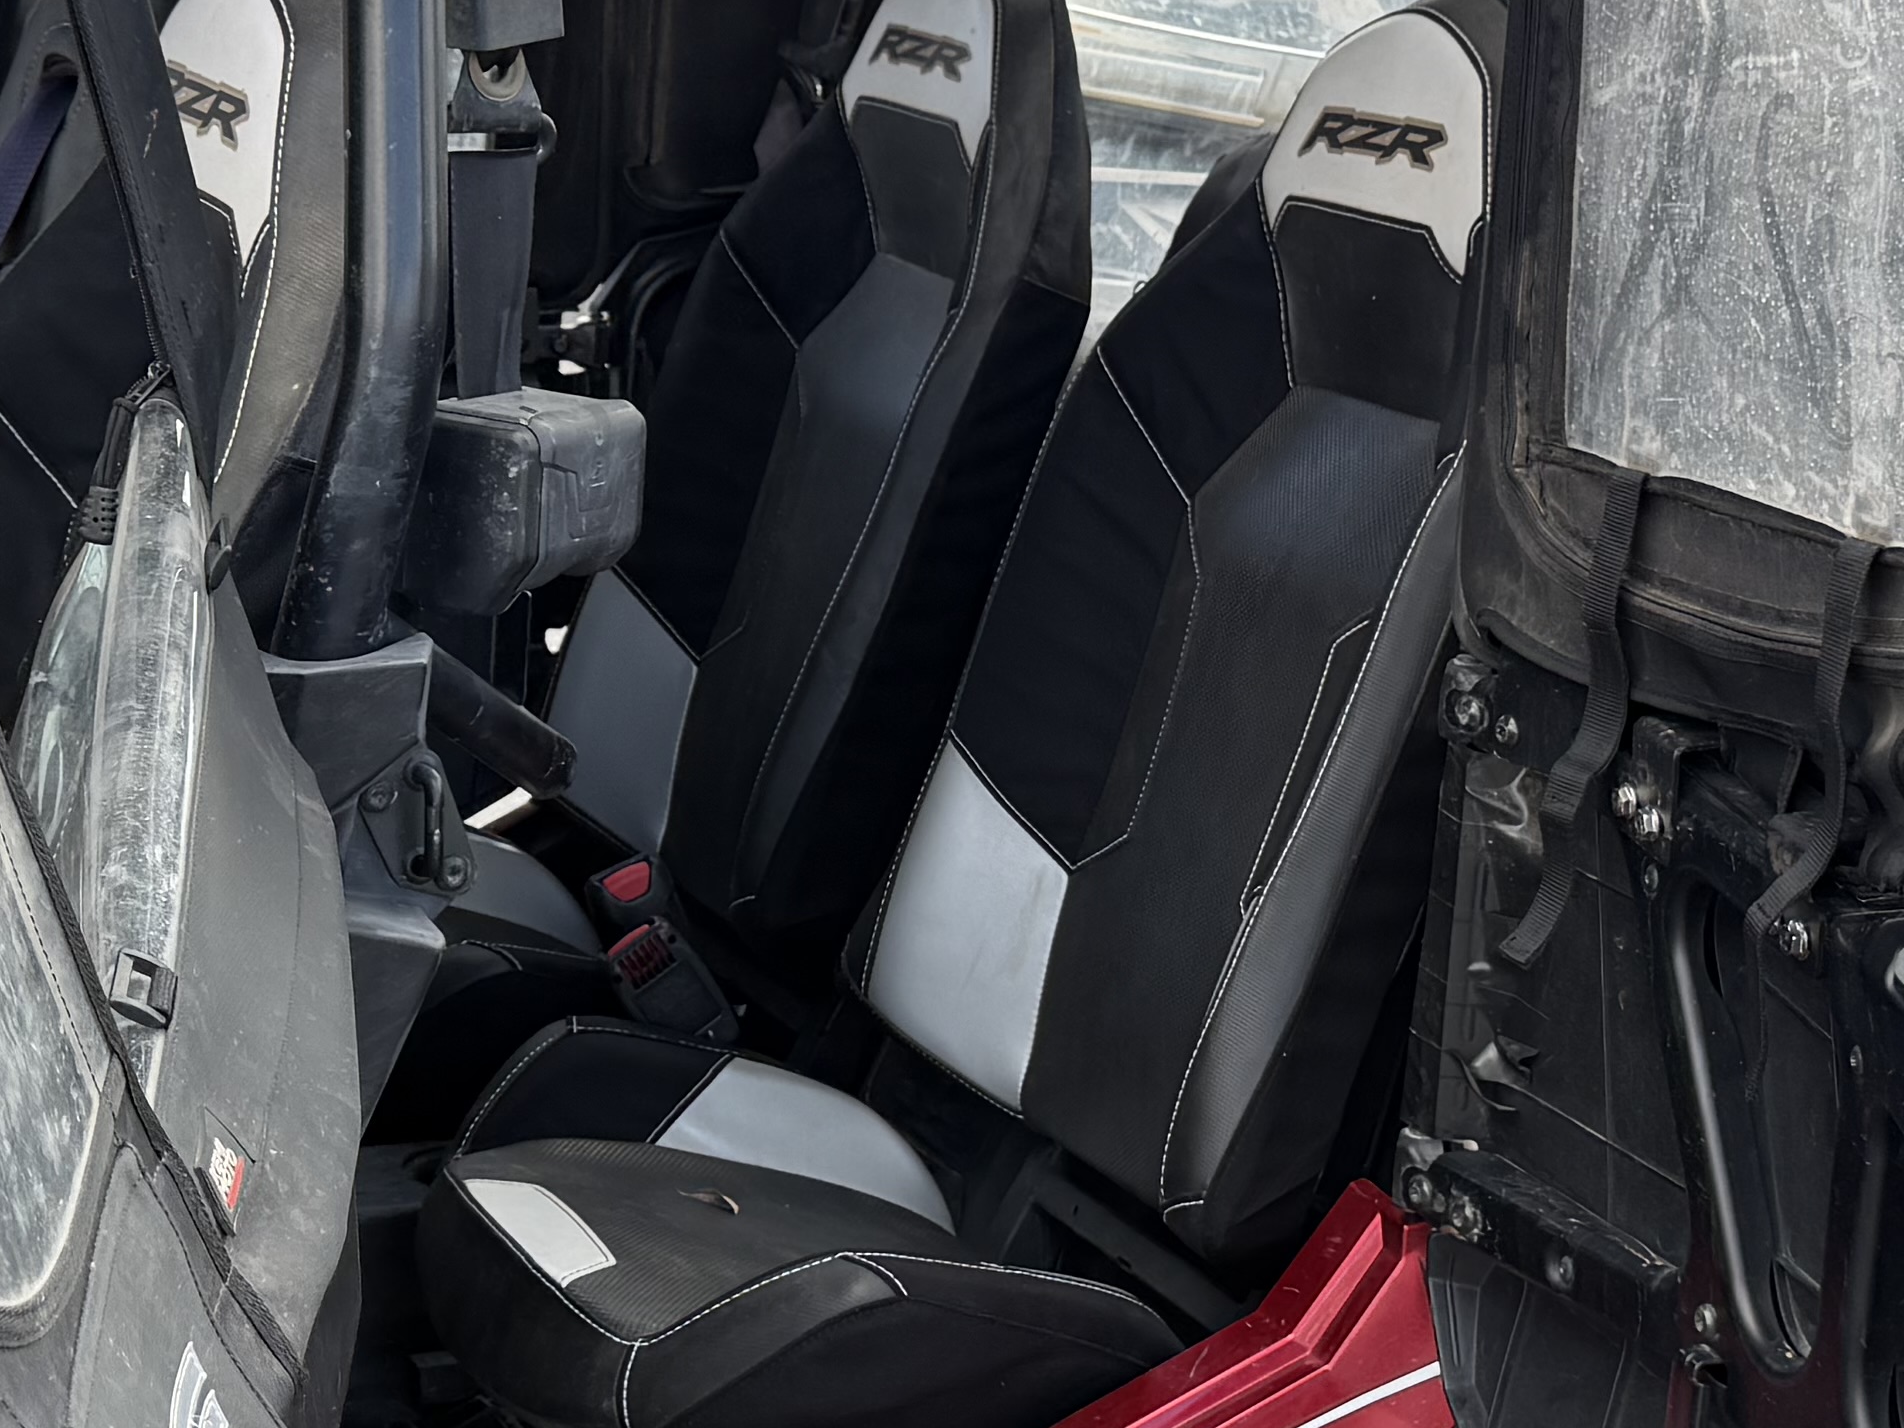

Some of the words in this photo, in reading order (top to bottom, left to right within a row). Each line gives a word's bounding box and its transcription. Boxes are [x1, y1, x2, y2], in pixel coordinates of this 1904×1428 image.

[868, 22, 973, 84] RZR
[166, 59, 251, 152] ZR
[1296, 105, 1449, 173] RZR
